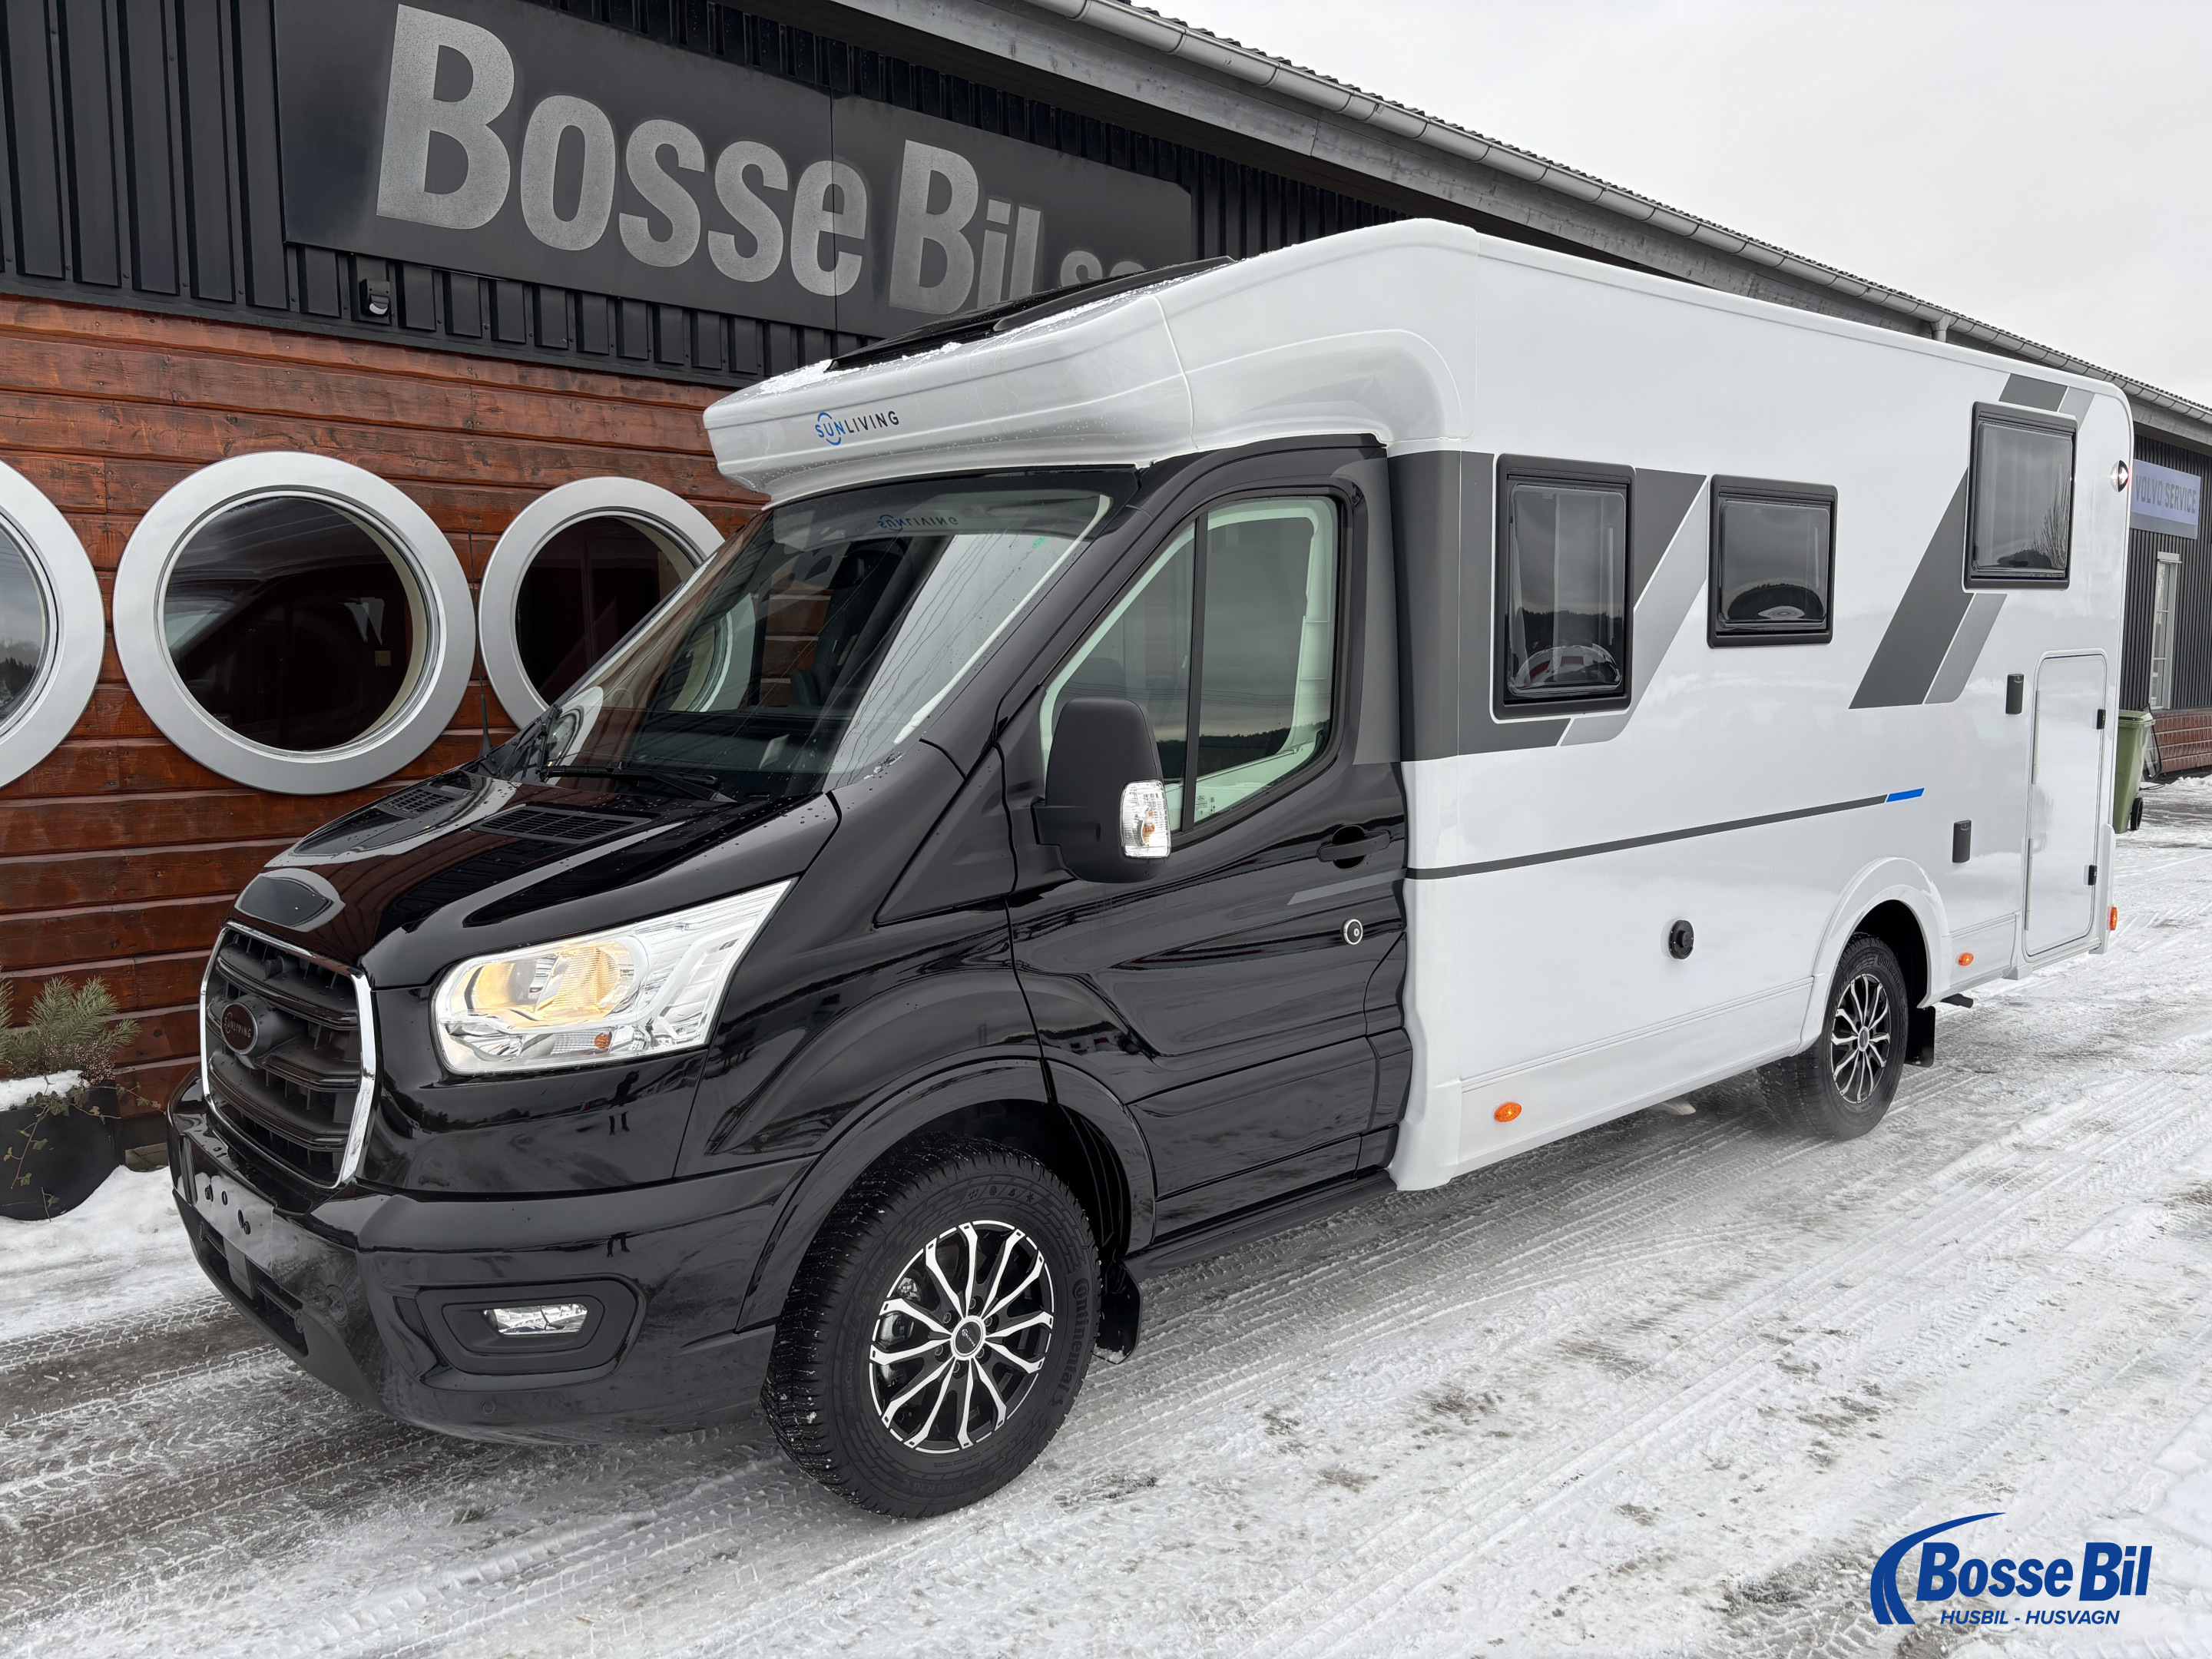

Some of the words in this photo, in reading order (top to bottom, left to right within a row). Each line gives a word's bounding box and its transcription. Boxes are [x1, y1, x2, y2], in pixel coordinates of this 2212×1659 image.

[376, 3, 869, 297] Bosse
[815, 411, 899, 445] SUNLIVING
[2135, 475, 2163, 506] VOLVO
[2164, 482, 2197, 514] SERVICE
[1057, 1277, 1090, 1392] Continental
